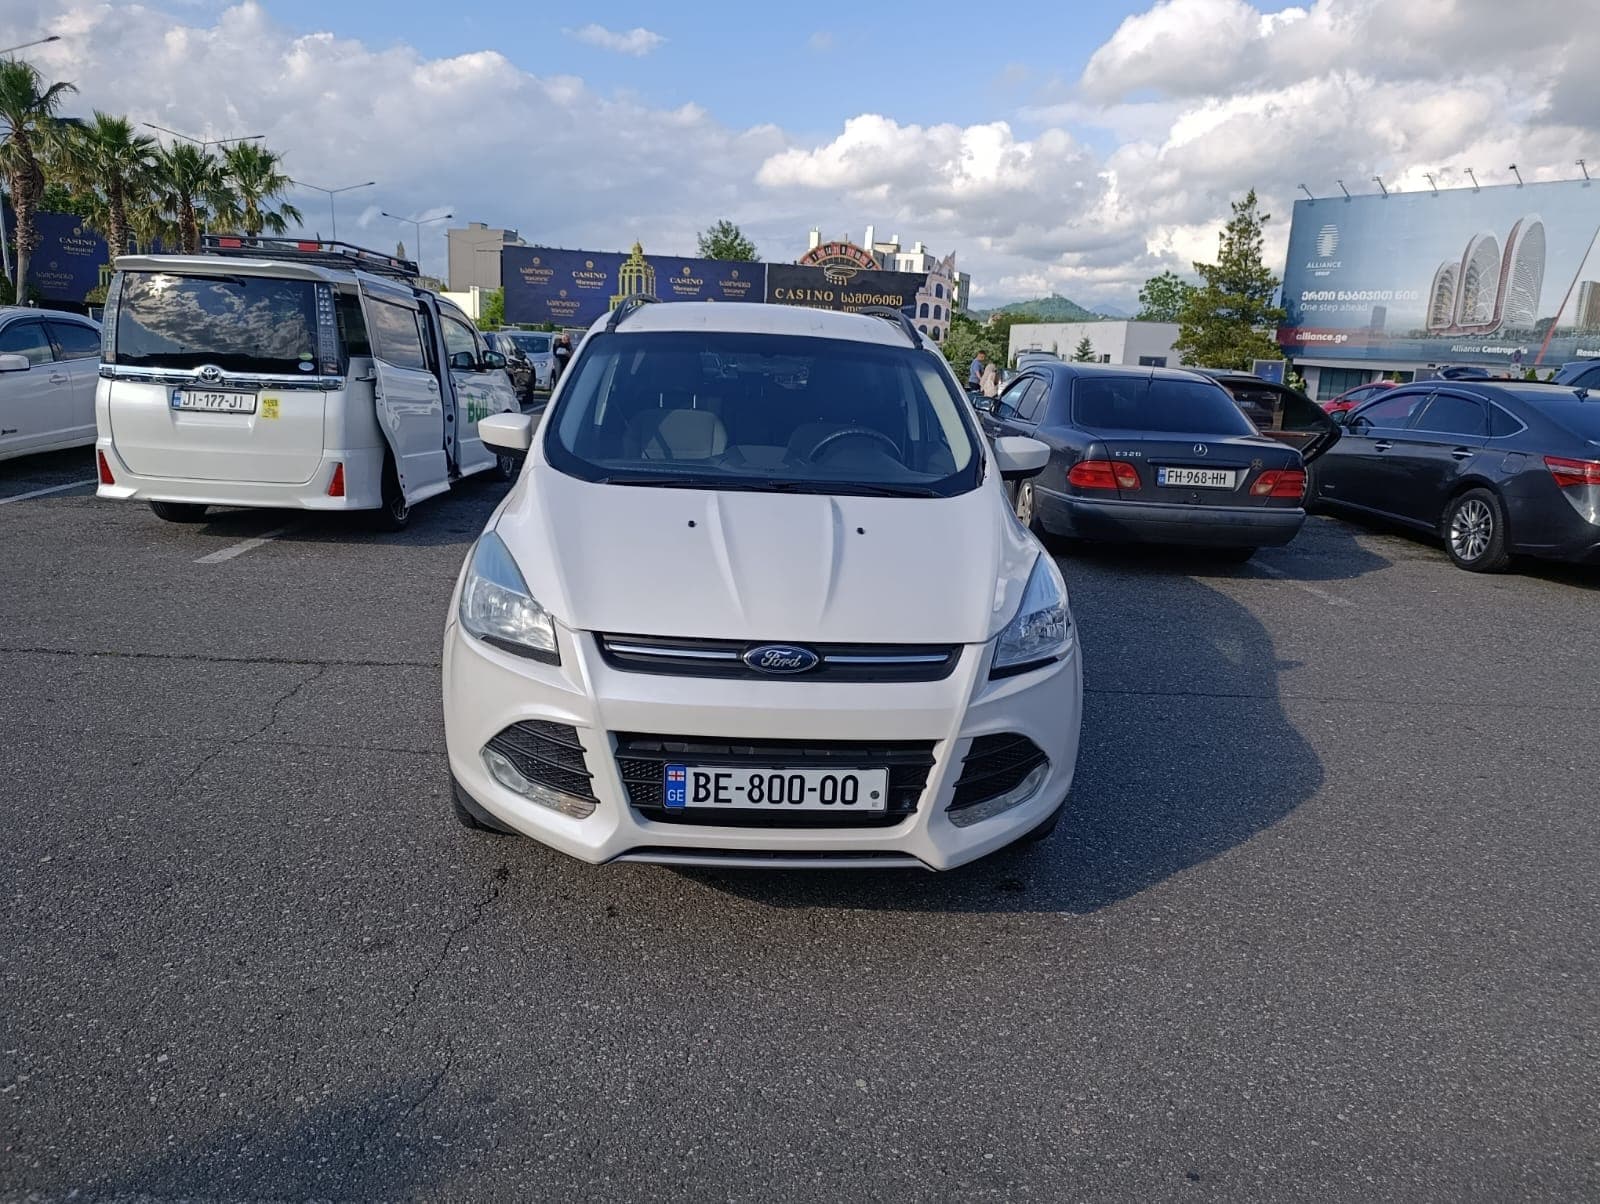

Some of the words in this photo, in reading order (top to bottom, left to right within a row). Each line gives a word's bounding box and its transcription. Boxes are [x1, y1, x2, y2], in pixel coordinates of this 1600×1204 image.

[1305, 261, 1342, 269] ALLIANCE
[572, 271, 607, 279] CASINO
[669, 277, 704, 285] CASINO
[774, 287, 834, 301] CASINO
[1300, 303, 1318, 312] One
[1320, 303, 1338, 313] step
[1340, 302, 1368, 312] ahead
[1296, 331, 1348, 344] alliance.ge
[1451, 345, 1480, 353] Alliance
[183, 393, 243, 408] JI-177-JI
[1167, 470, 1227, 485] FH-968-HH
[761, 649, 802, 667] Ford
[692, 771, 859, 806] BE-800-00
[667, 789, 684, 802] GE
